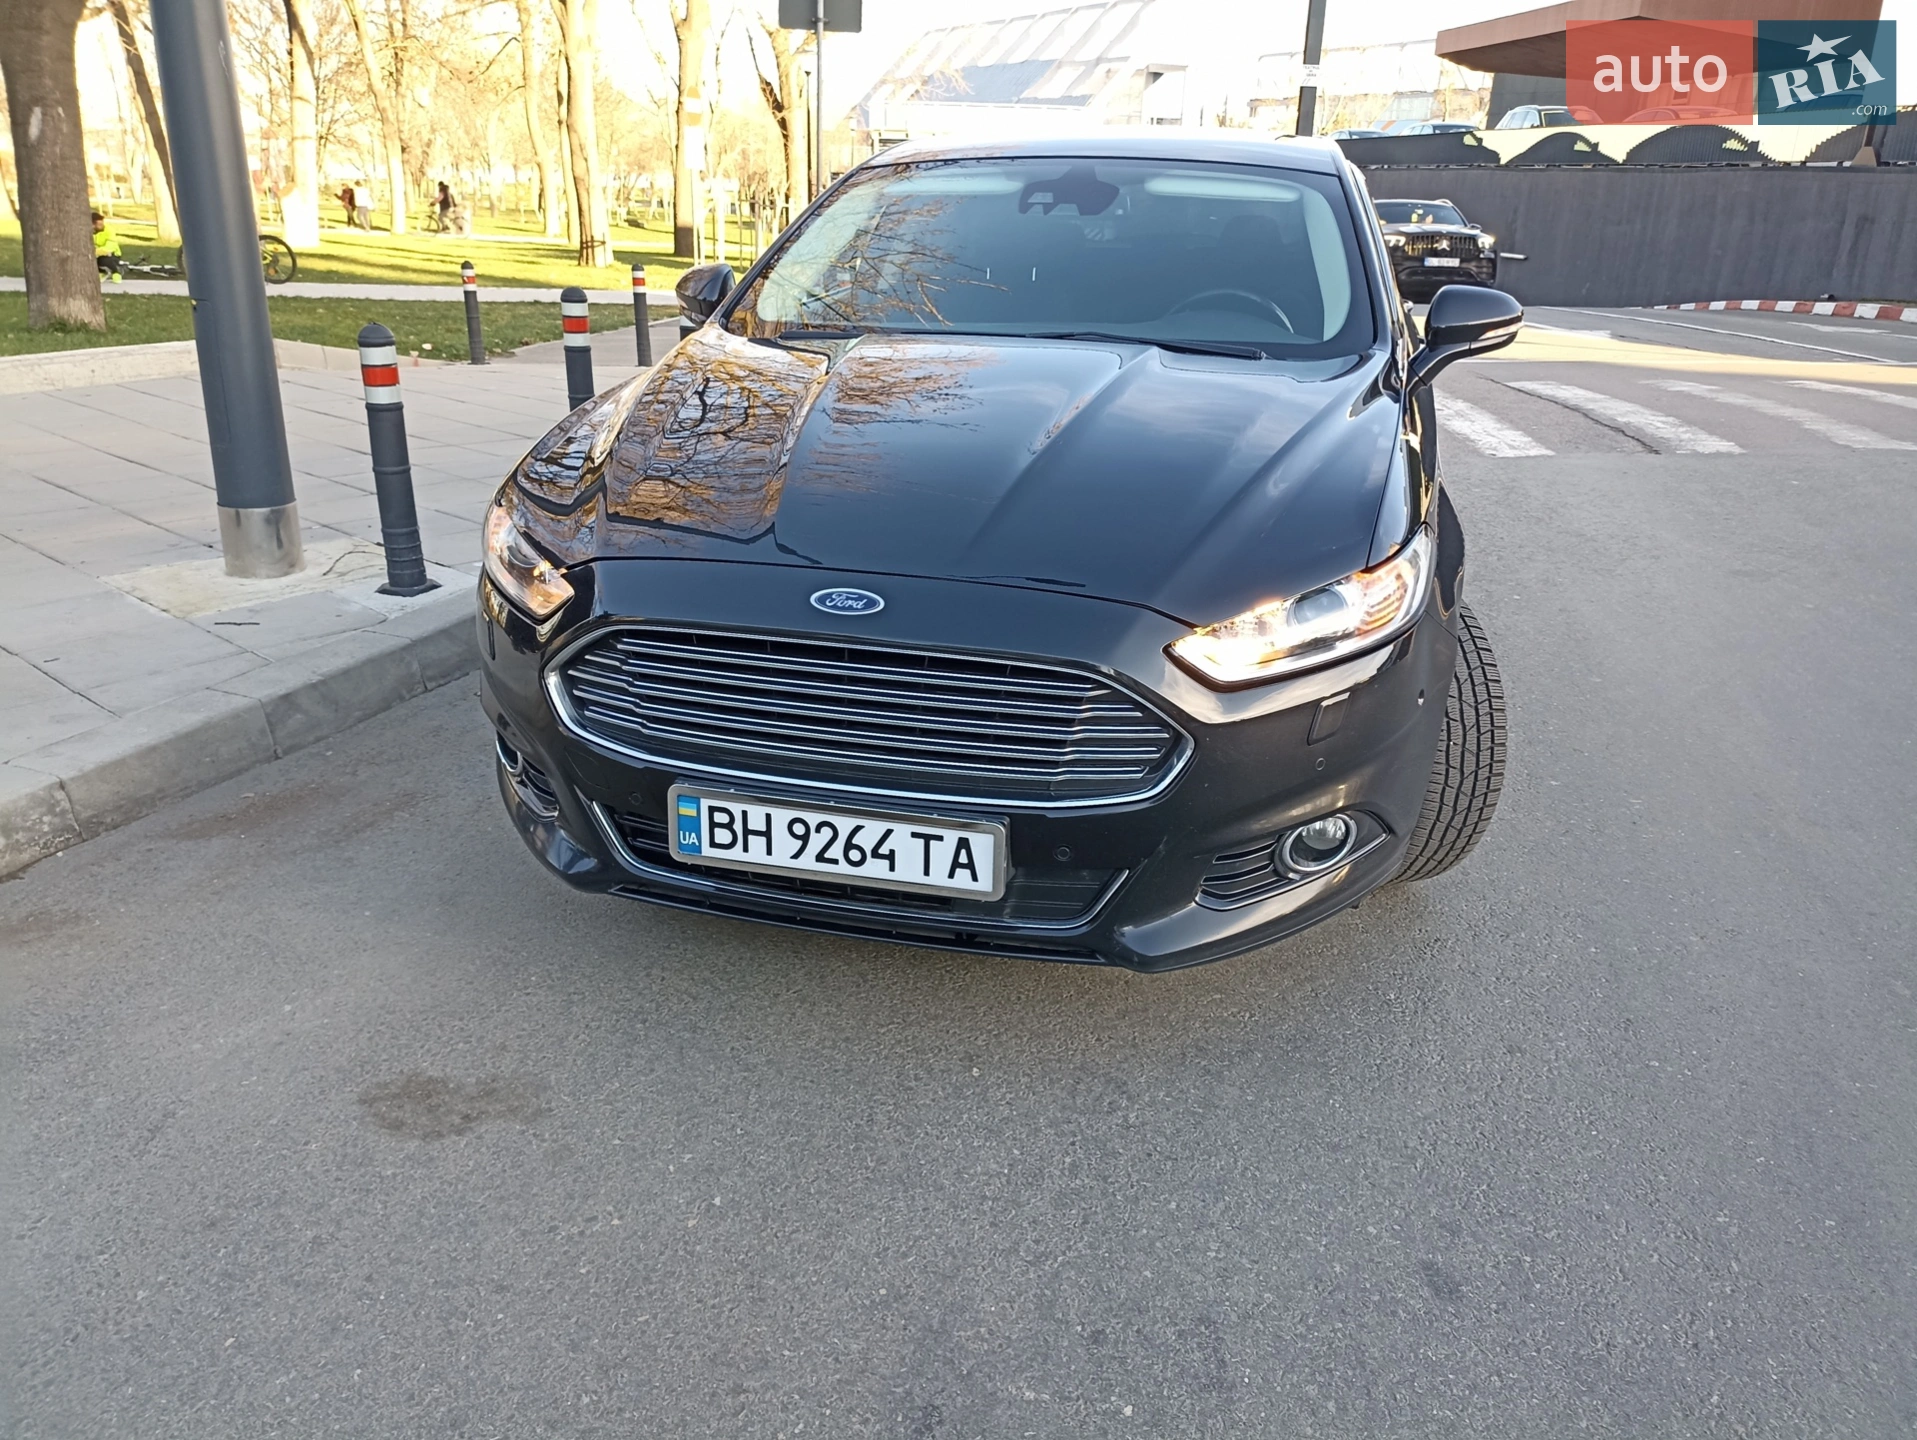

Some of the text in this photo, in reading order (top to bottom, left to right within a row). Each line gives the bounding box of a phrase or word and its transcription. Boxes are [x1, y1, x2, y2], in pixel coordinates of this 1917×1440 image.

[825, 592, 868, 609] Ford
[679, 830, 699, 846] UA
[707, 805, 979, 883] BH 9264 TA
